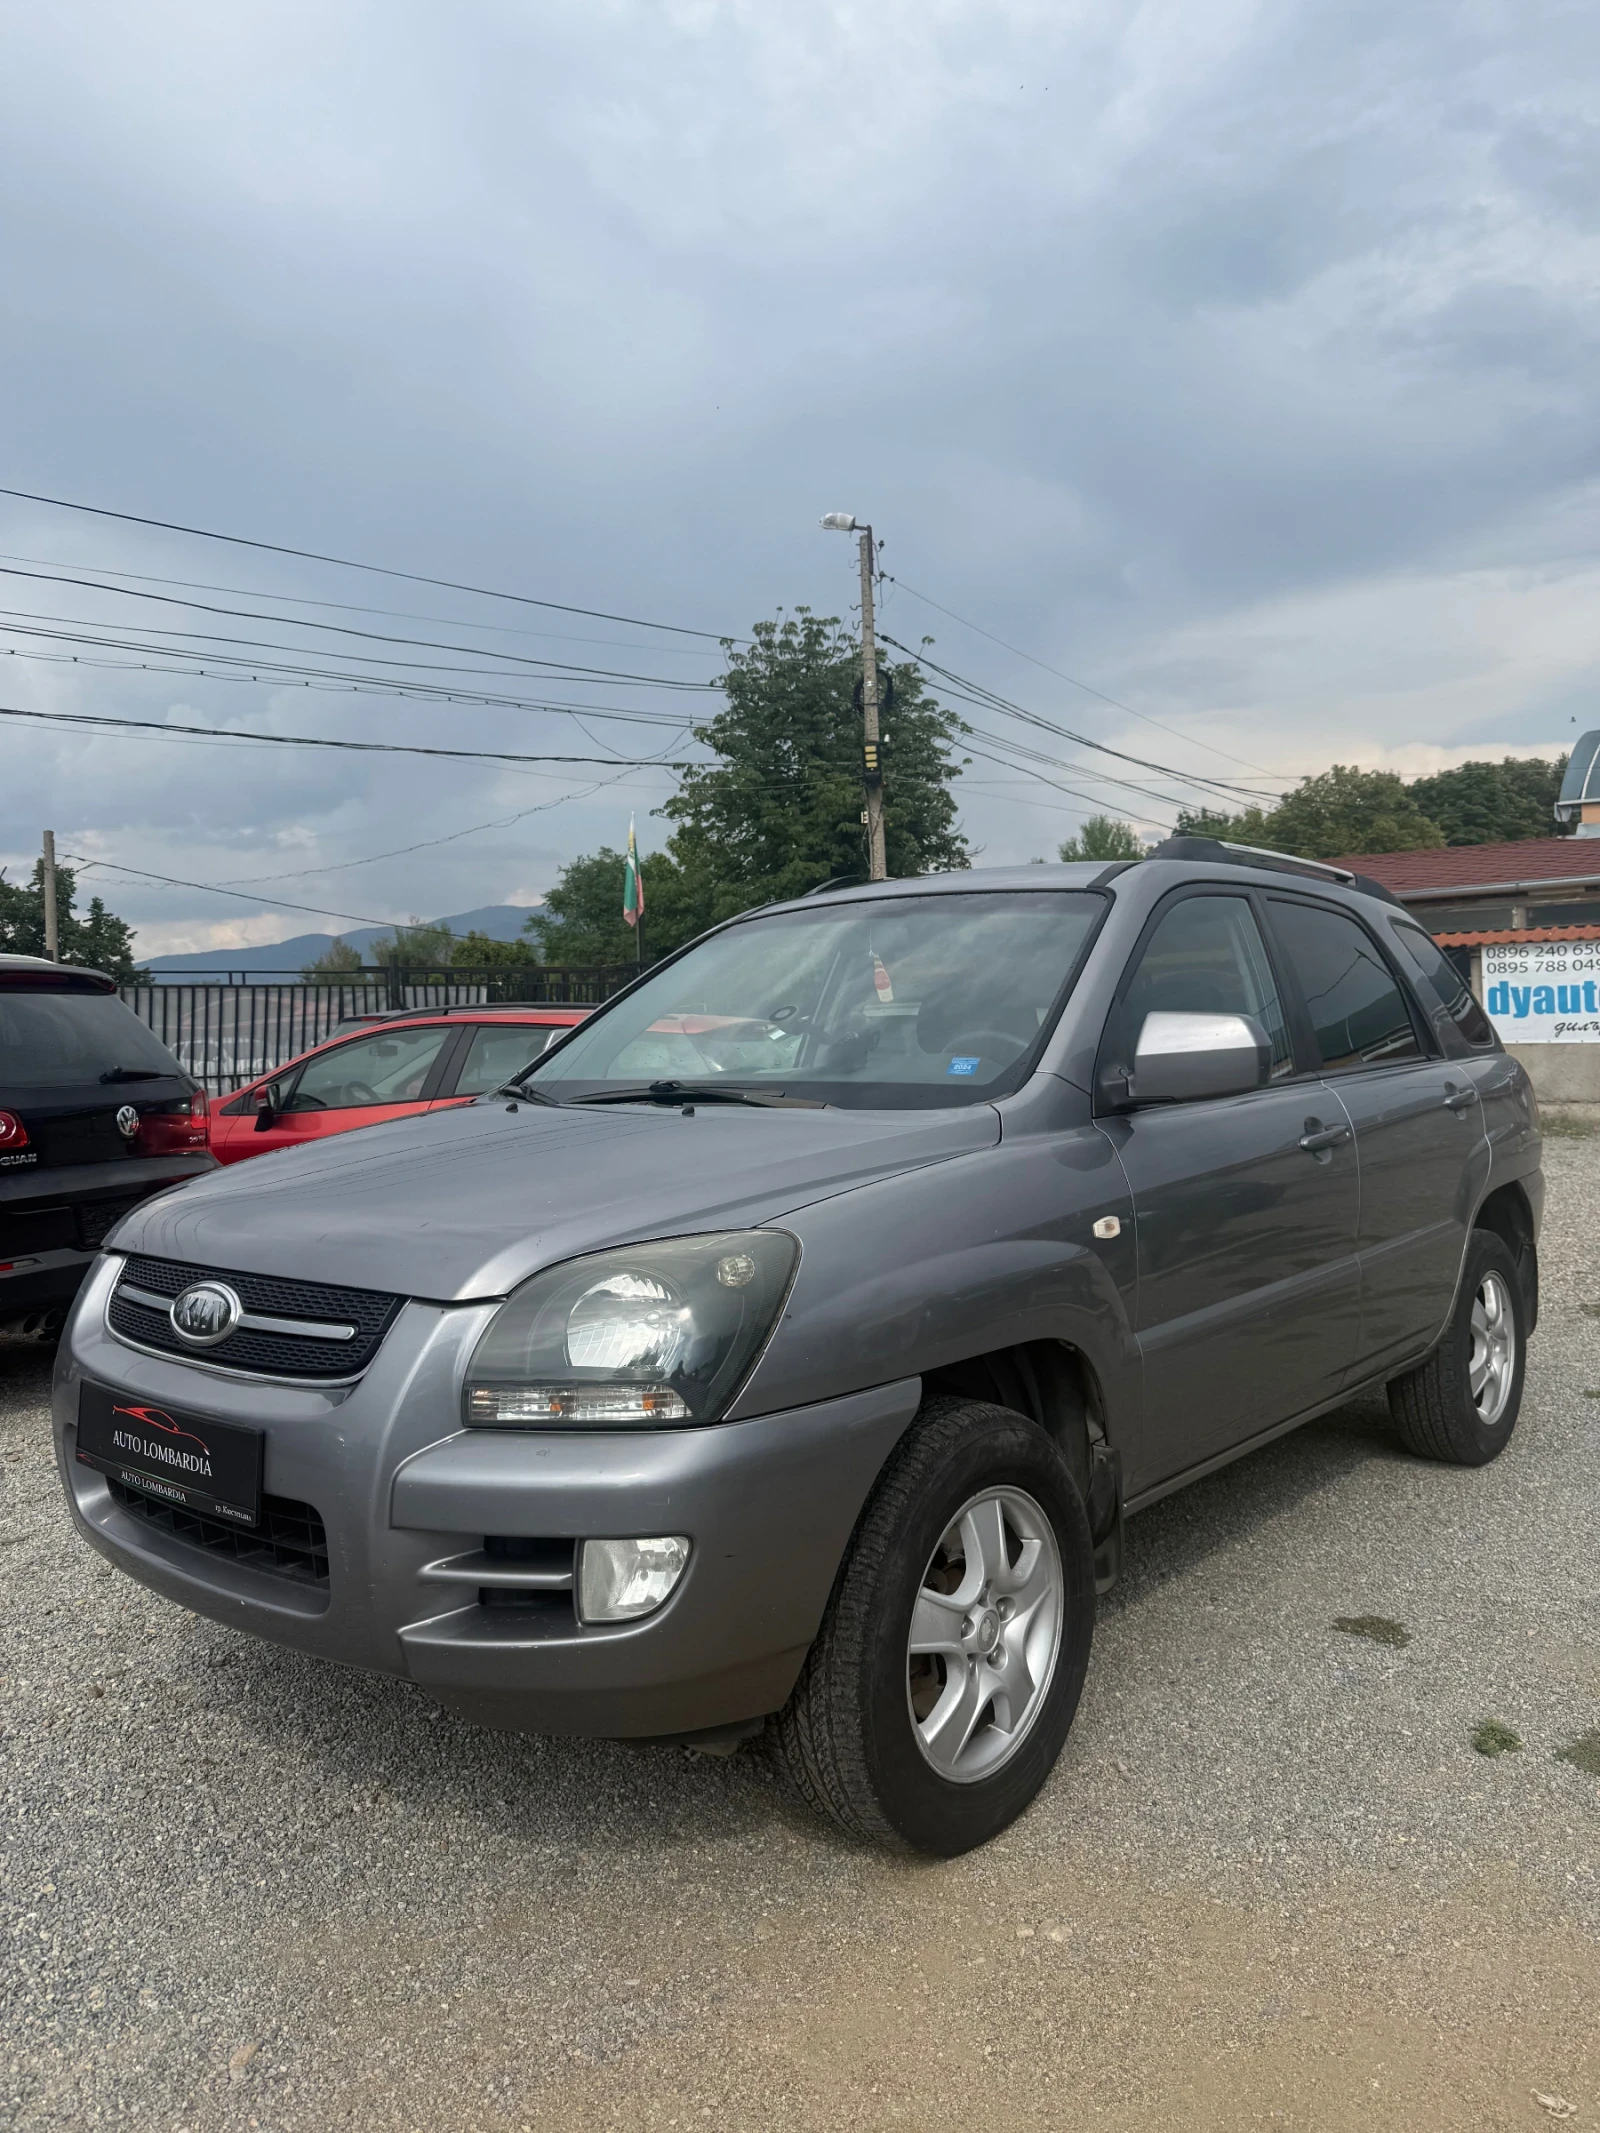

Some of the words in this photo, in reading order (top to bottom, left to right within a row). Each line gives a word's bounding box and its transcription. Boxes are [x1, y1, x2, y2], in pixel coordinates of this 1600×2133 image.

[1486, 946, 1529, 959] 0896
[1534, 945, 1568, 957] 240
[1487, 961, 1528, 974] 0895
[1534, 960, 1567, 973] 788
[1487, 980, 1600, 1018] dyaut
[1554, 1021, 1600, 1038] дилъ
[113, 1430, 141, 1453] AUTO
[143, 1440, 213, 1477] LOMBARDIA
[121, 1471, 141, 1486] AUTO
[142, 1479, 187, 1503] LOMBARDIA
